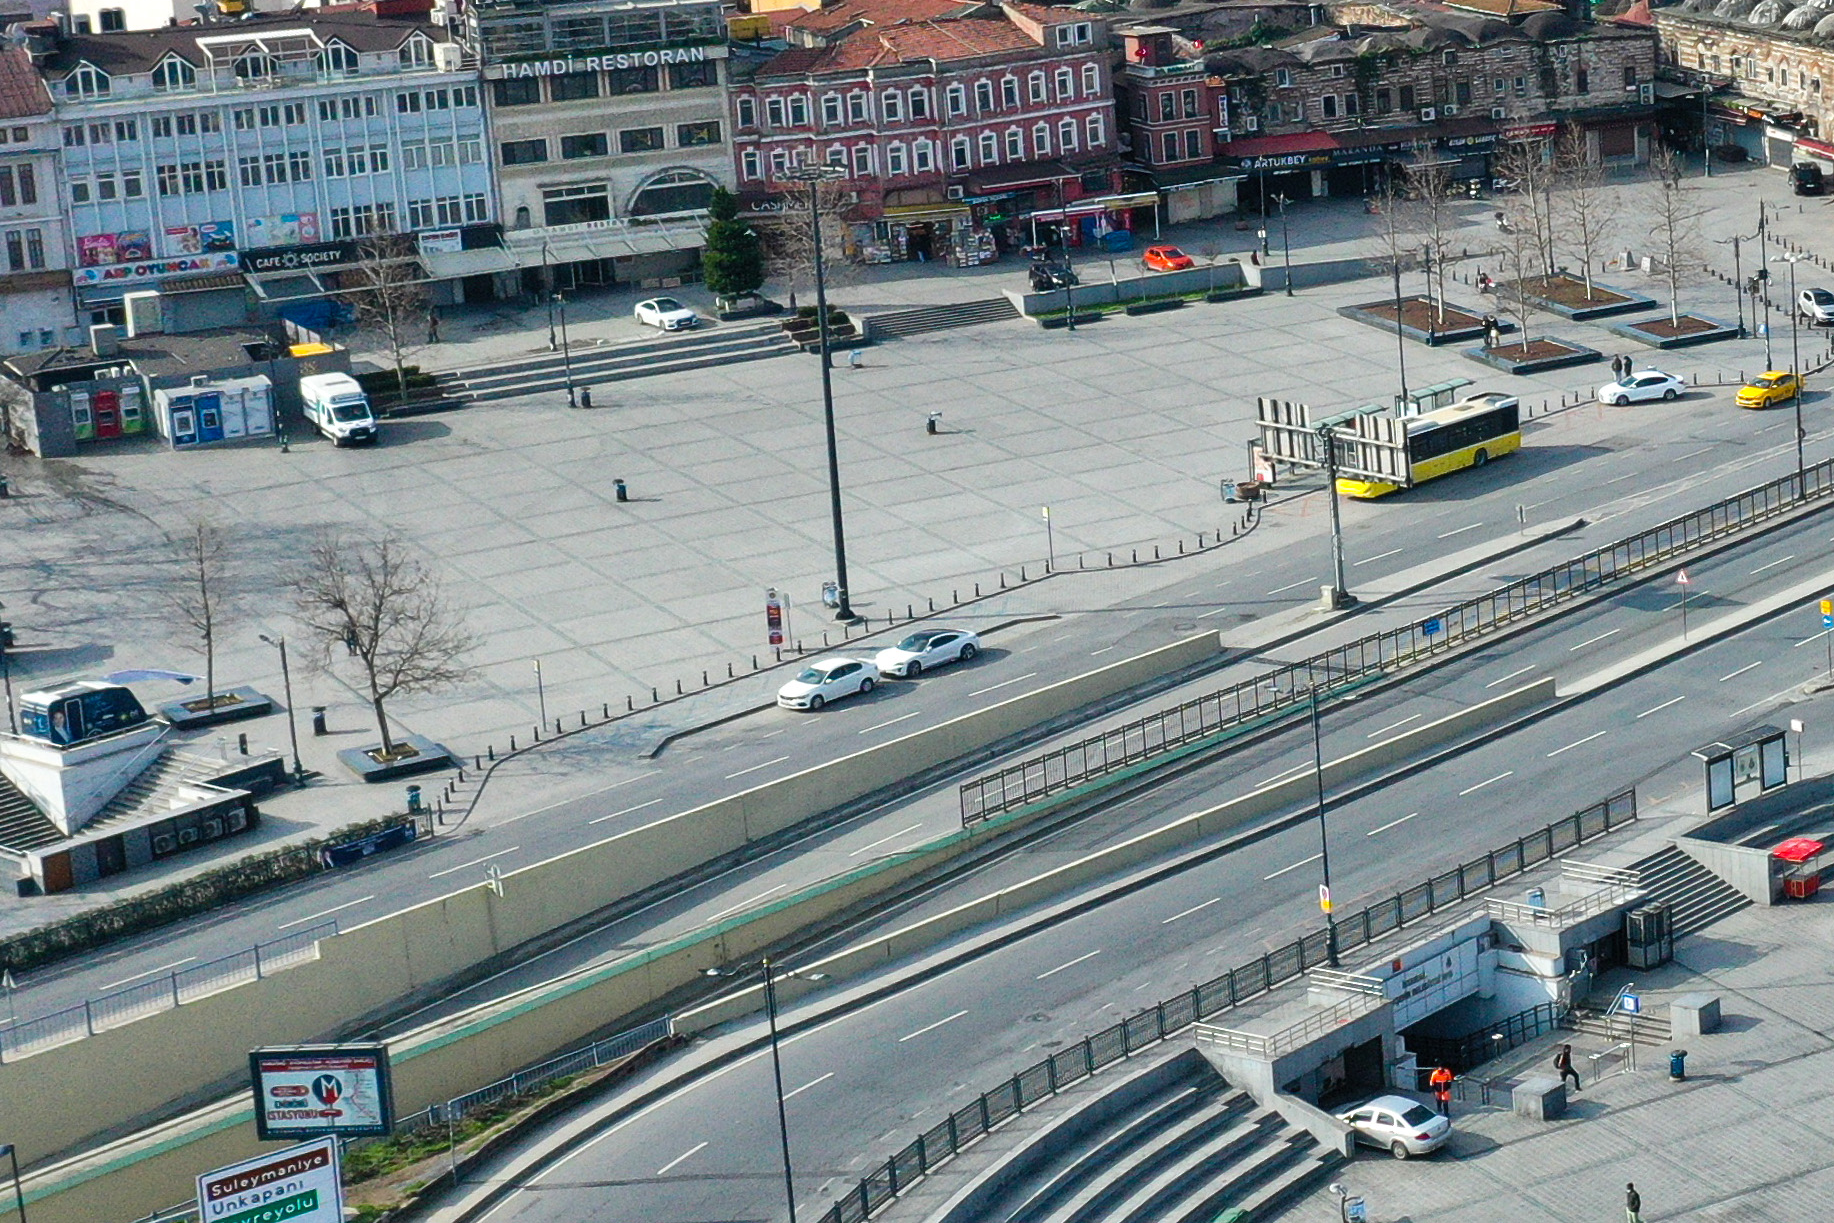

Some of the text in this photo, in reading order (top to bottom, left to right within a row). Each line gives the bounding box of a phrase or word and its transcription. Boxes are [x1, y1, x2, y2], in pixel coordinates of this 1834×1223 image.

[586, 47, 705, 72] RESTORAN
[1254, 155, 1307, 169] ARTUKBEY
[256, 250, 342, 269] CAFE SOCIETY
